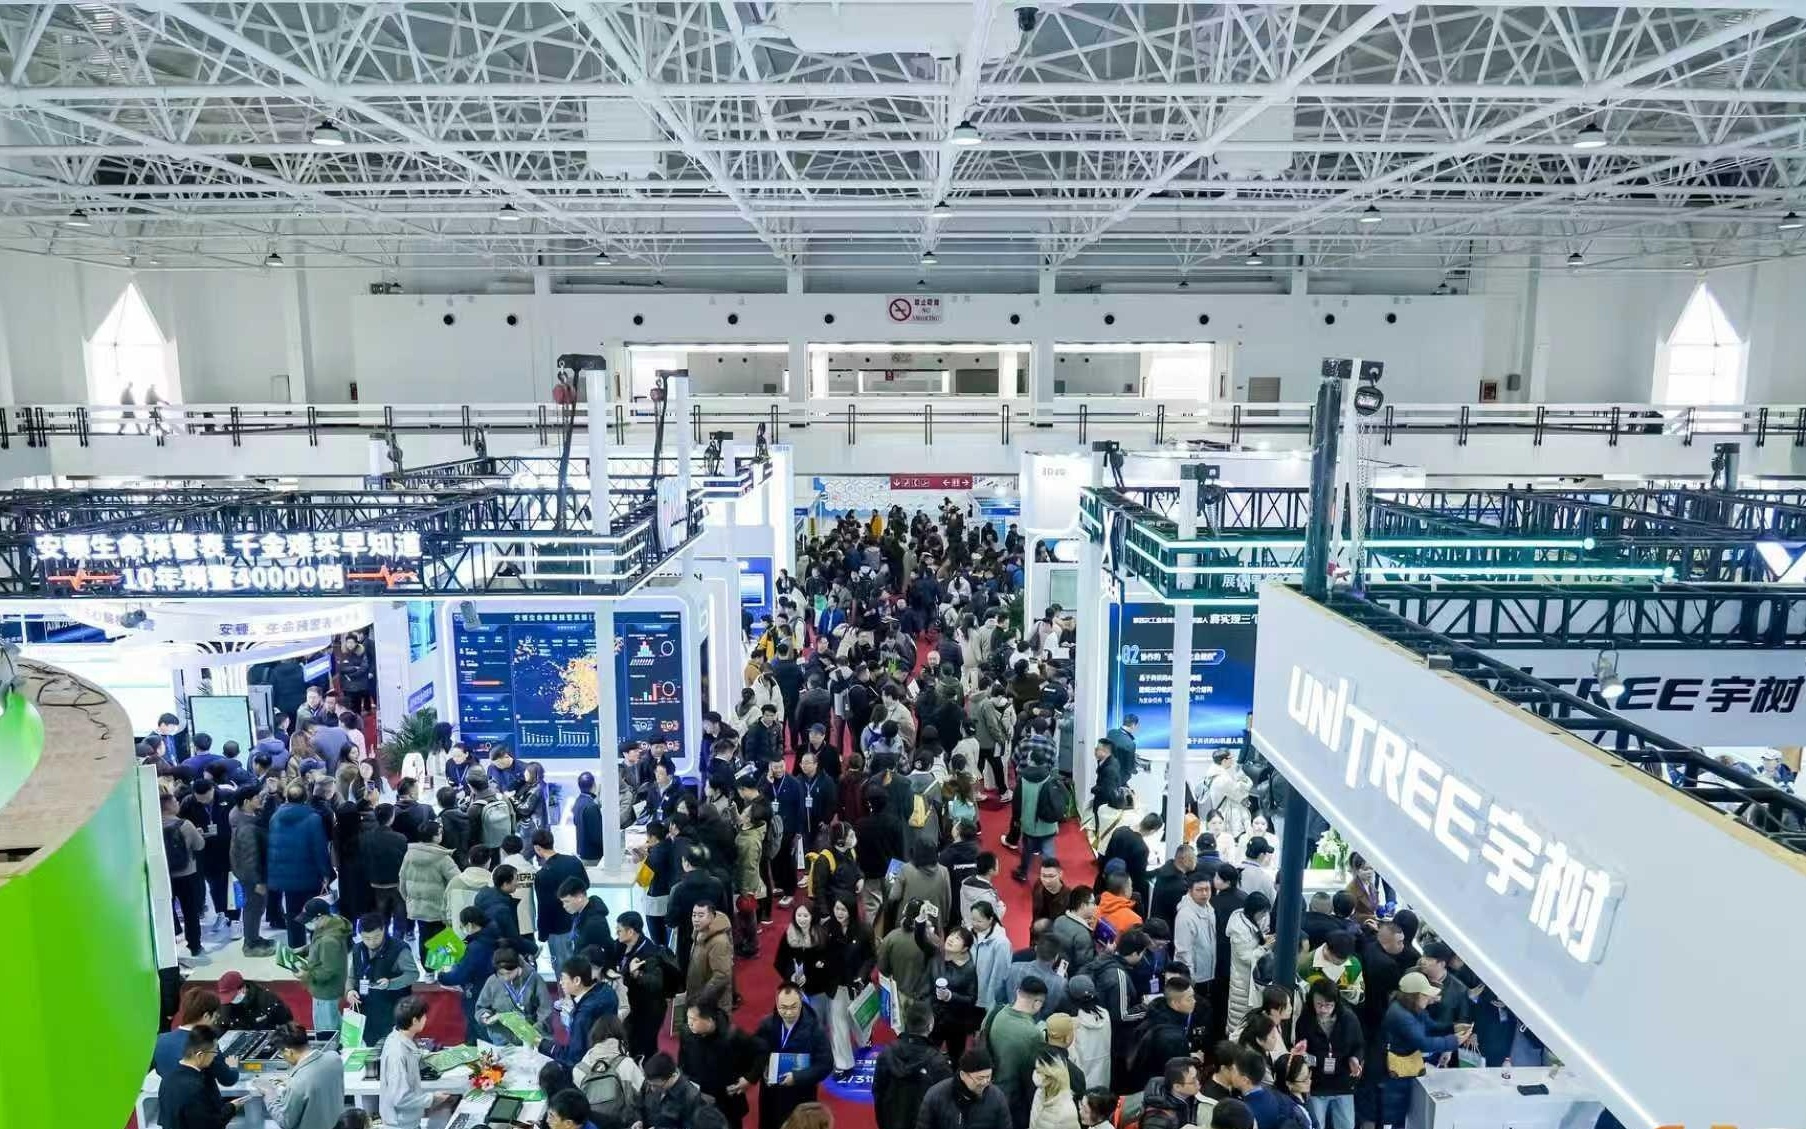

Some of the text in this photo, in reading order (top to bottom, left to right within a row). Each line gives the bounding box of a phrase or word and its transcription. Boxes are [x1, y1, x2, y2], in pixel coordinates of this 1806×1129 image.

[231, 532, 422, 558] 千金难买早知道
[1121, 645, 1140, 665] 02
[1706, 675, 1805, 713] 宇树
[1287, 665, 1612, 963] UNITREE 宇树
